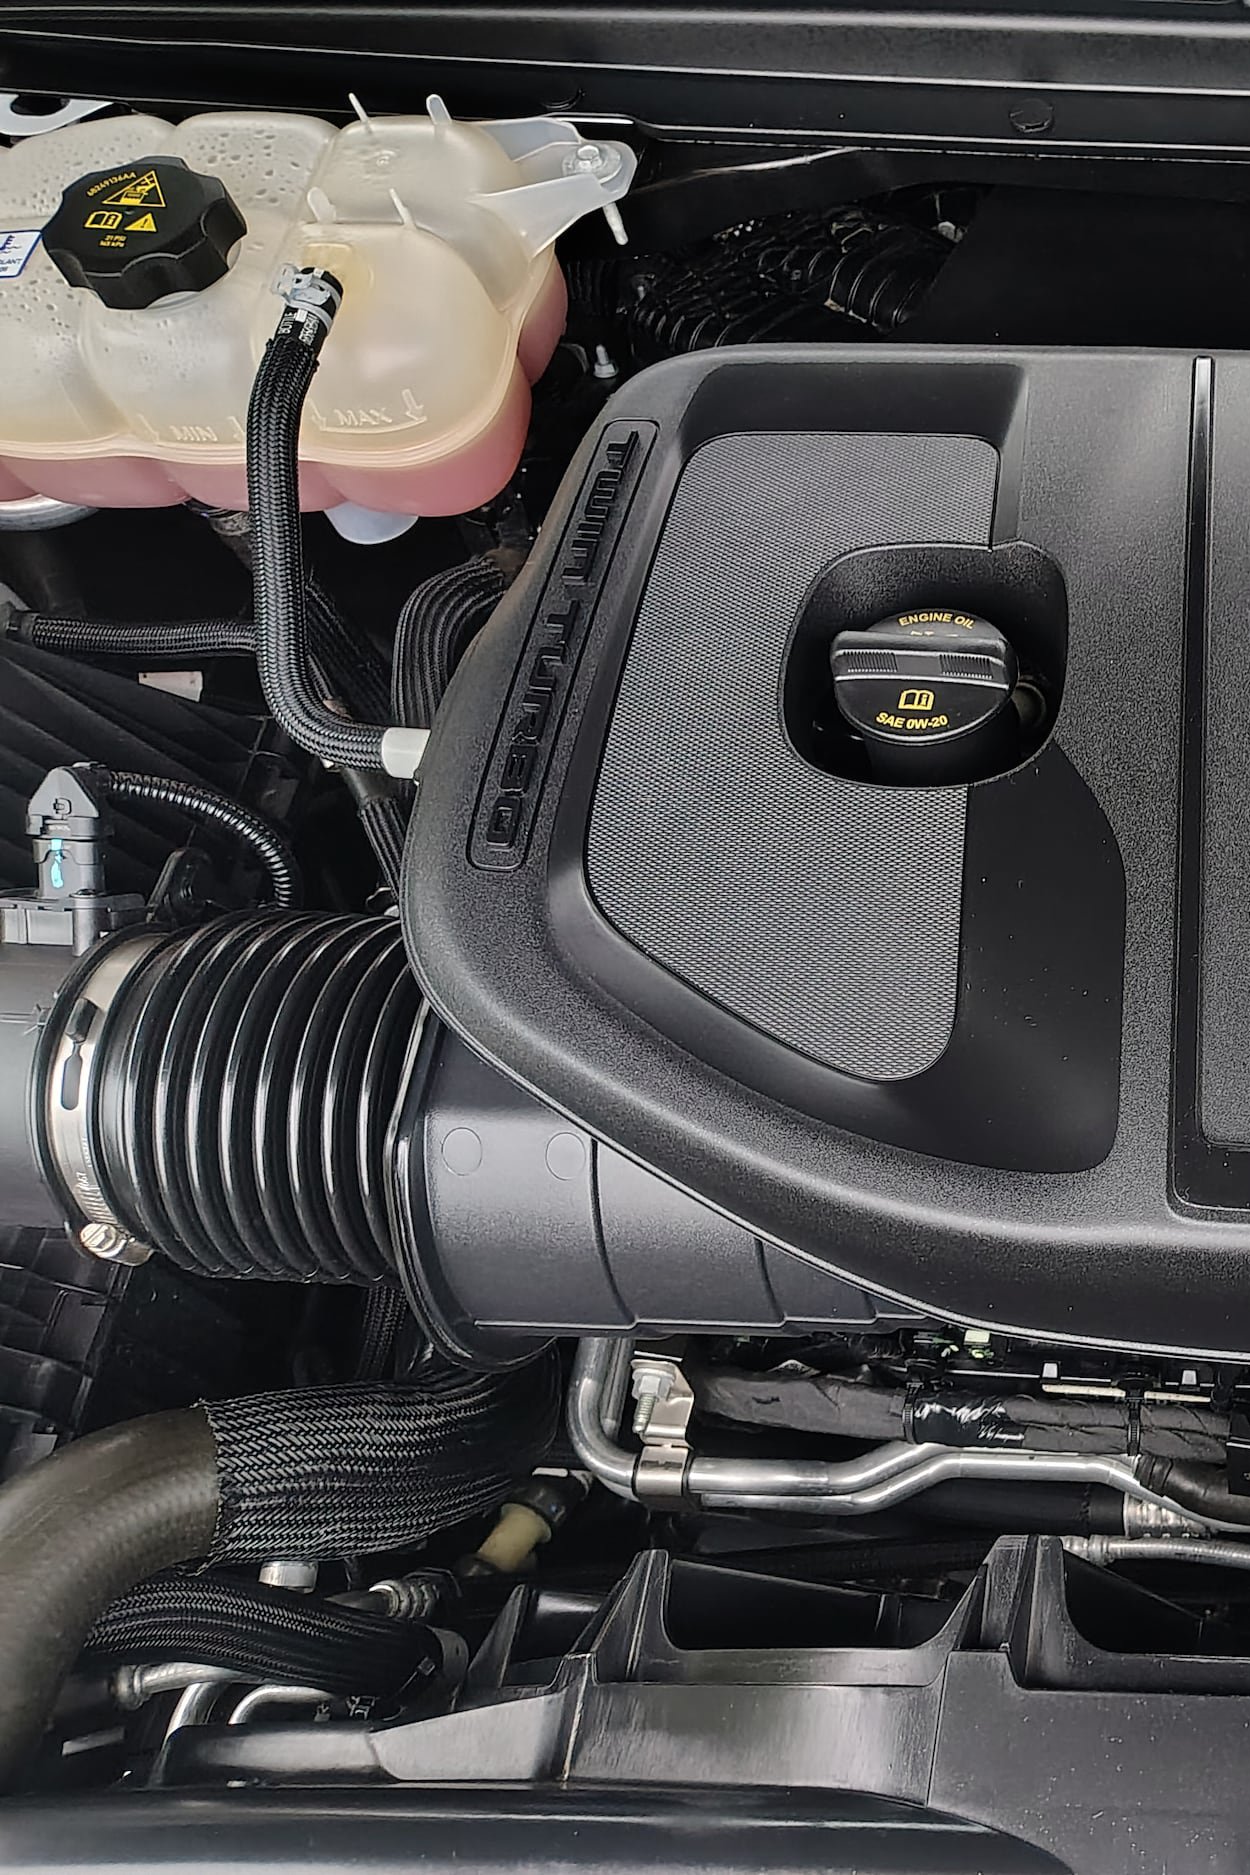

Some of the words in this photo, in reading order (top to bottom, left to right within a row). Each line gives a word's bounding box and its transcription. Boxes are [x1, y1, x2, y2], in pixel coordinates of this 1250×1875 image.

[333, 408, 393, 427] MAX
[169, 425, 218, 442] MIN
[561, 429, 640, 586] TWIN
[899, 612, 953, 626] ENGINE
[954, 615, 975, 630] OIL
[486, 599, 583, 846] TURBO
[876, 712, 905, 729] SAE
[906, 714, 948, 730] 0W-20
